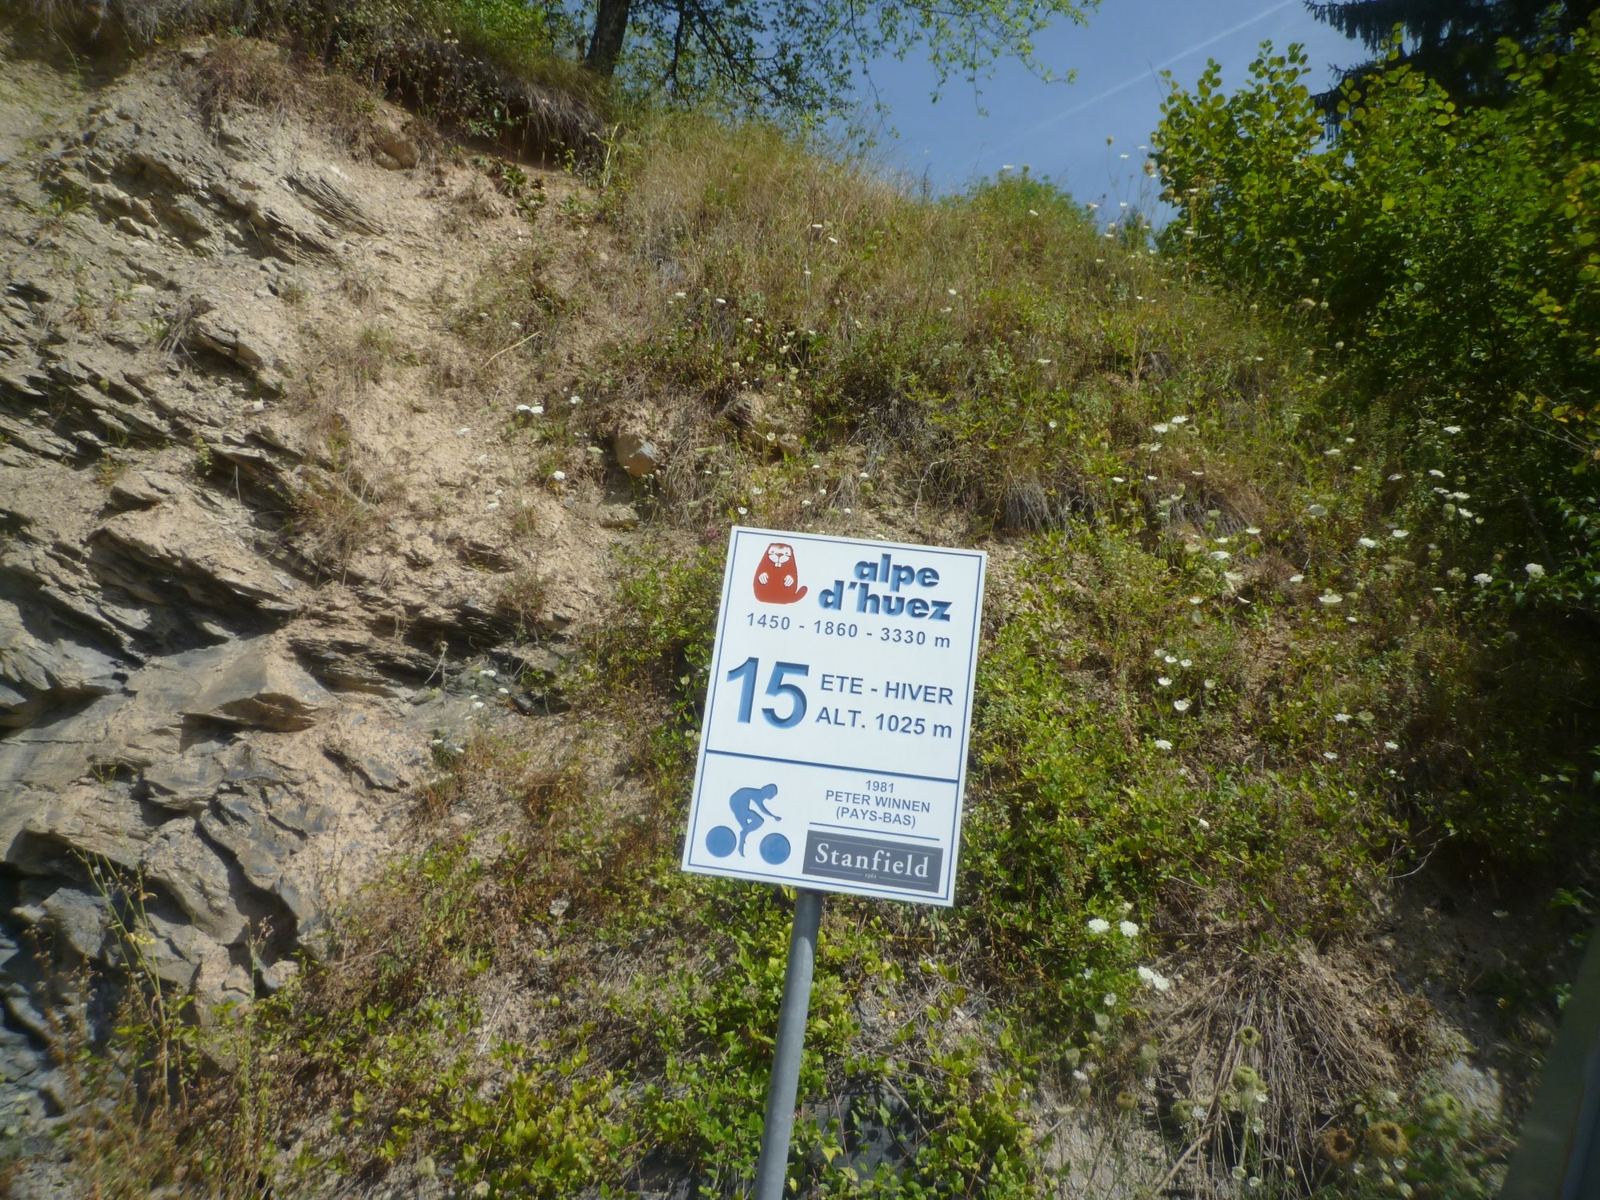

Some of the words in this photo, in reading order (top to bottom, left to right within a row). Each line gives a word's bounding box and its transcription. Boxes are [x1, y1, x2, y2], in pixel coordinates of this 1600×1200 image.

[854, 553, 940, 592] alpe
[818, 580, 952, 622] d'huez
[747, 613, 791, 630] 1450
[814, 620, 858, 638] 1860
[880, 628, 926, 645] 3330
[935, 636, 950, 648] m
[726, 656, 810, 730] 15
[821, 674, 864, 695] ETE
[885, 681, 954, 704] HIVER
[815, 706, 865, 729] ALT.
[876, 713, 926, 735] 1025
[933, 724, 952, 738] m
[826, 790, 871, 806] PETER
[875, 796, 930, 812] WINNEN
[865, 780, 894, 793] 1981
[836, 806, 916, 828] (PAYS-BAS)
[815, 843, 929, 878] Stanfield
